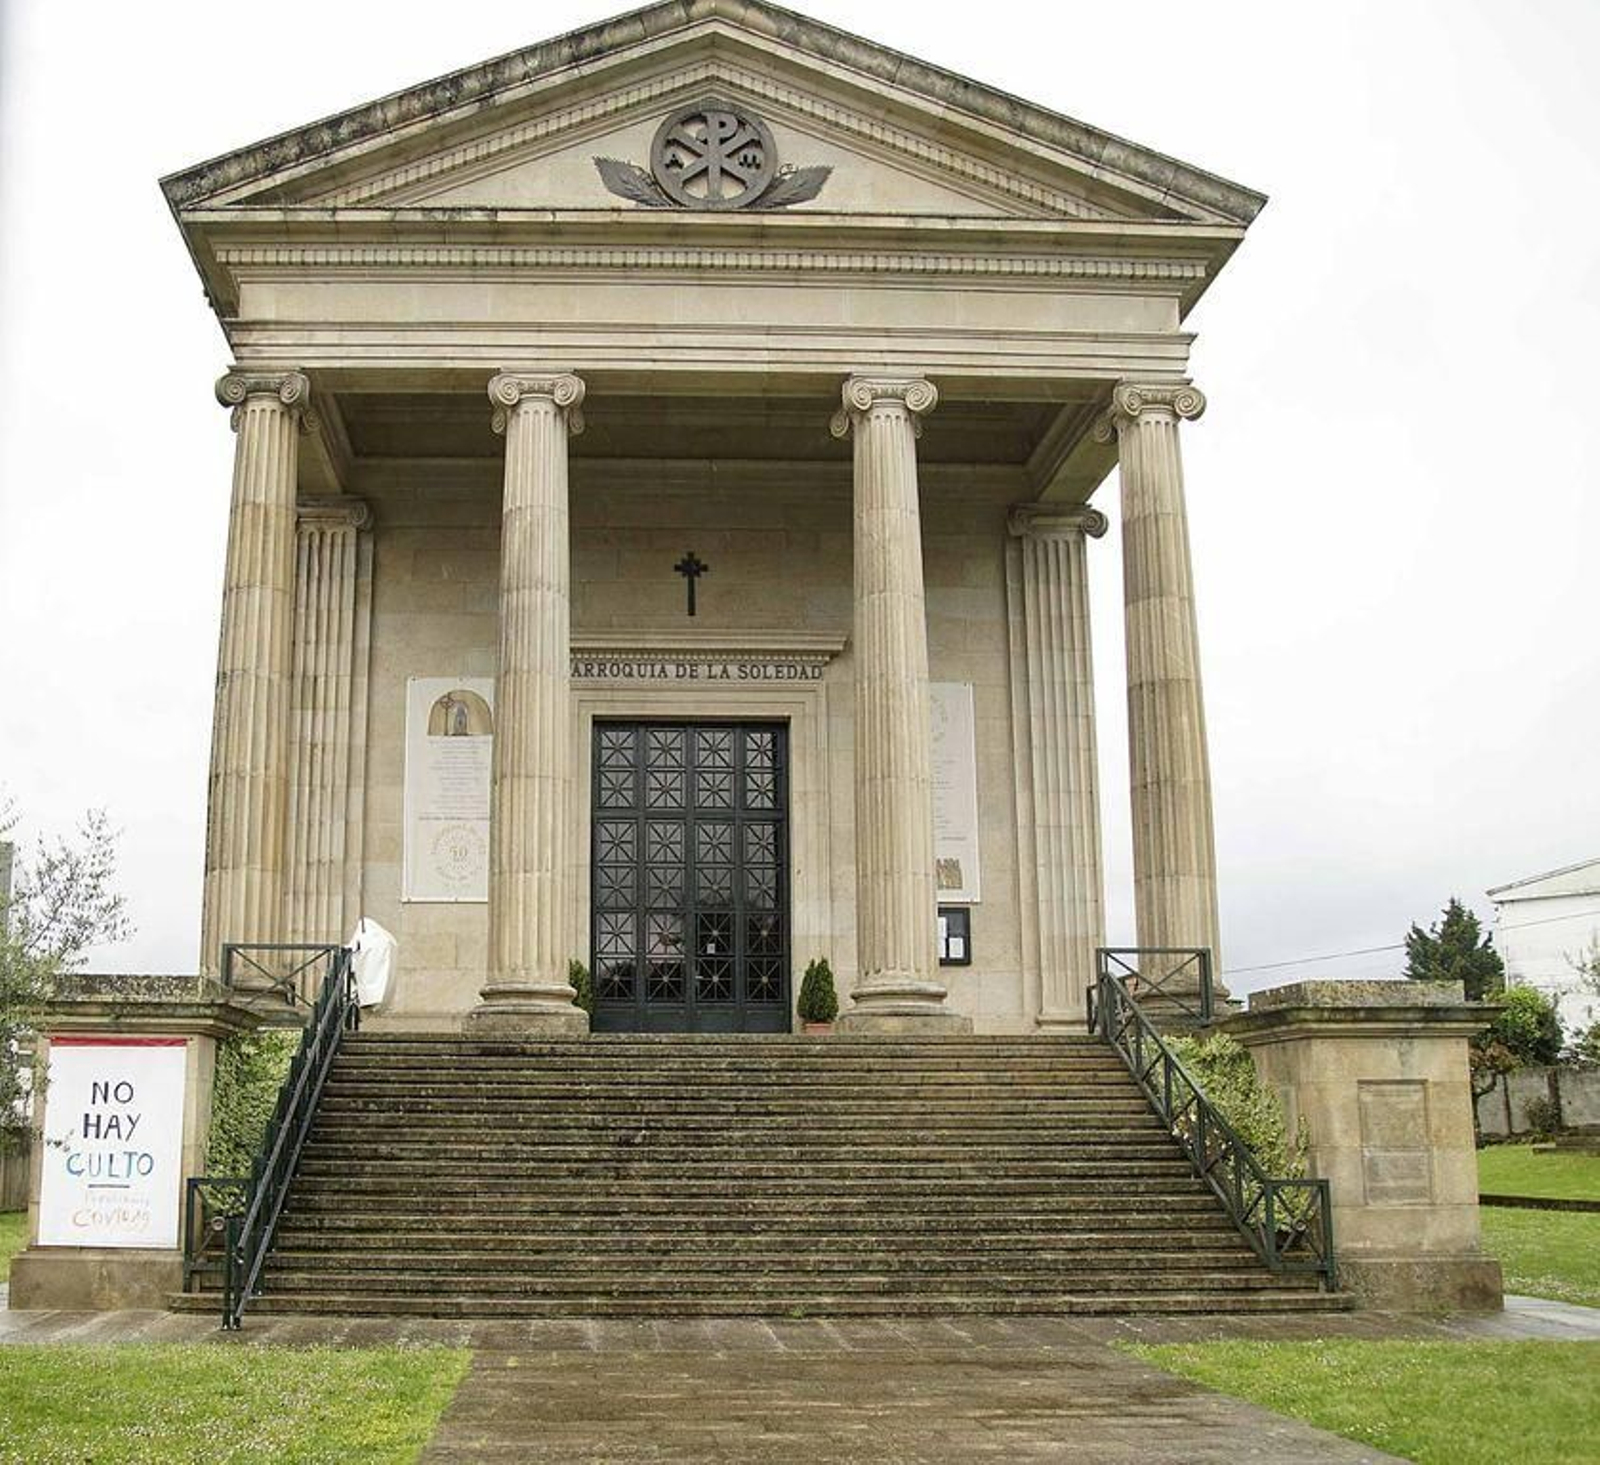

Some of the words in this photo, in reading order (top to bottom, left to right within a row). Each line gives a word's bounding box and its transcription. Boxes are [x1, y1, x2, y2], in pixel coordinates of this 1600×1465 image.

[571, 662, 668, 679] ARROQUIA
[675, 663, 698, 679] DE
[707, 664, 730, 680] LA
[737, 664, 823, 681] SOLEDAD
[91, 1081, 134, 1105] NO
[83, 1113, 142, 1141] HAY
[66, 1151, 154, 1178] CULTO
